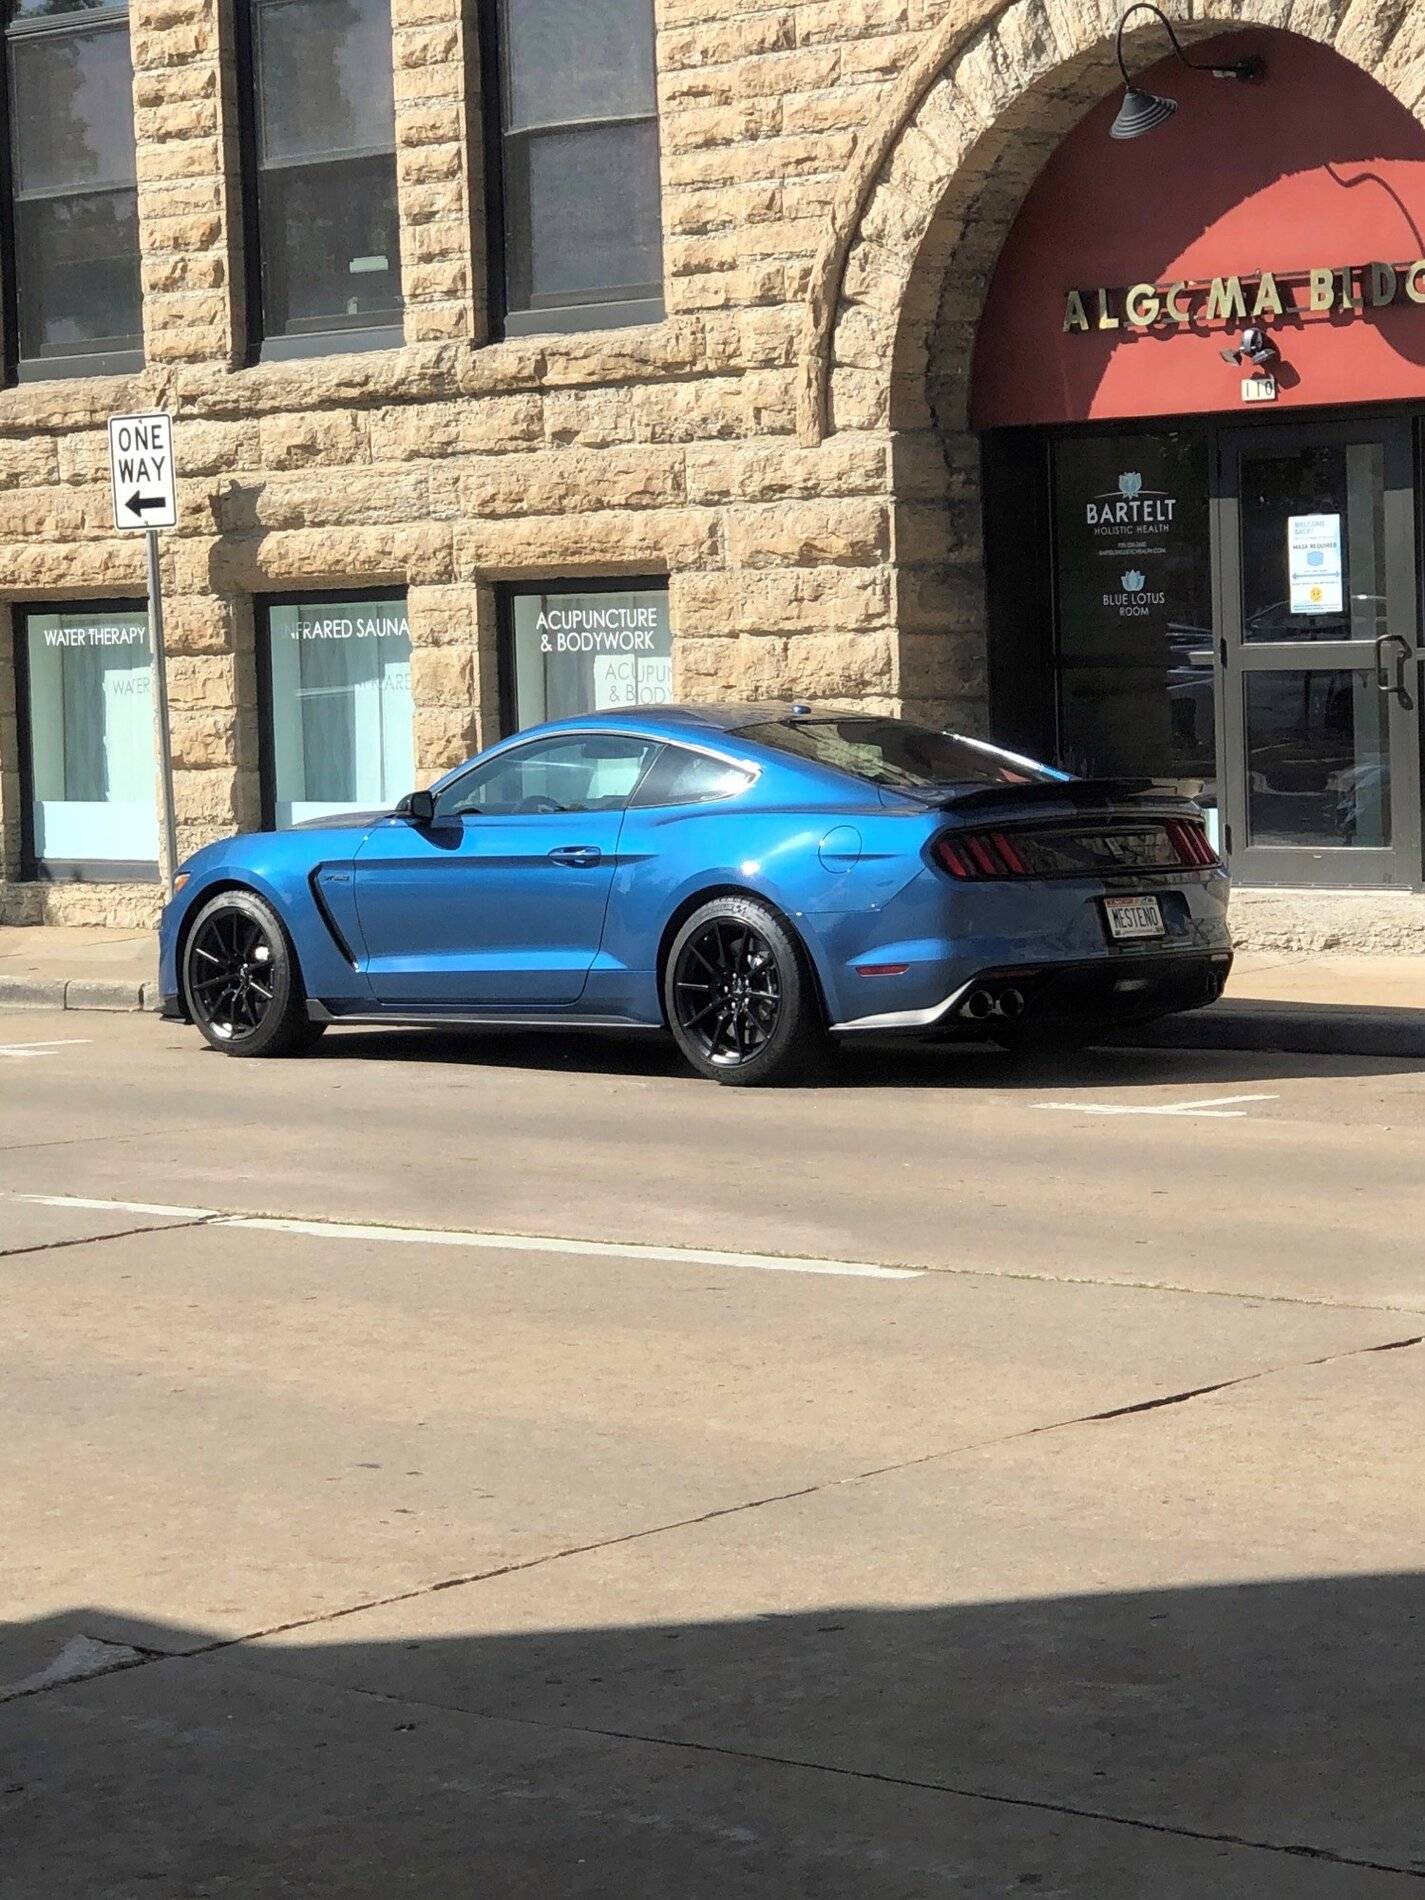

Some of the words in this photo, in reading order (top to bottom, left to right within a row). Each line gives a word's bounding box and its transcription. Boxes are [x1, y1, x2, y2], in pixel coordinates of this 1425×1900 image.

[1244, 378, 1273, 398] 110
[118, 424, 164, 452] ONE
[118, 455, 166, 484] WAY
[1086, 499, 1176, 524] BARTELT
[1094, 526, 1134, 536] HOLISTIC
[1137, 523, 1170, 534] HEALTH
[1103, 594, 1129, 606] BLUE
[1131, 592, 1165, 605] LOTUS
[536, 608, 658, 630] ACUPUNCTURE
[1119, 606, 1149, 616] ROOM
[44, 628, 86, 646] WATER
[87, 627, 146, 645] THERAPY
[356, 617, 410, 638] SAUNA
[540, 633, 553, 652] &
[557, 630, 655, 652] BODYWORK
[1112, 906, 1159, 929] MESTENO
